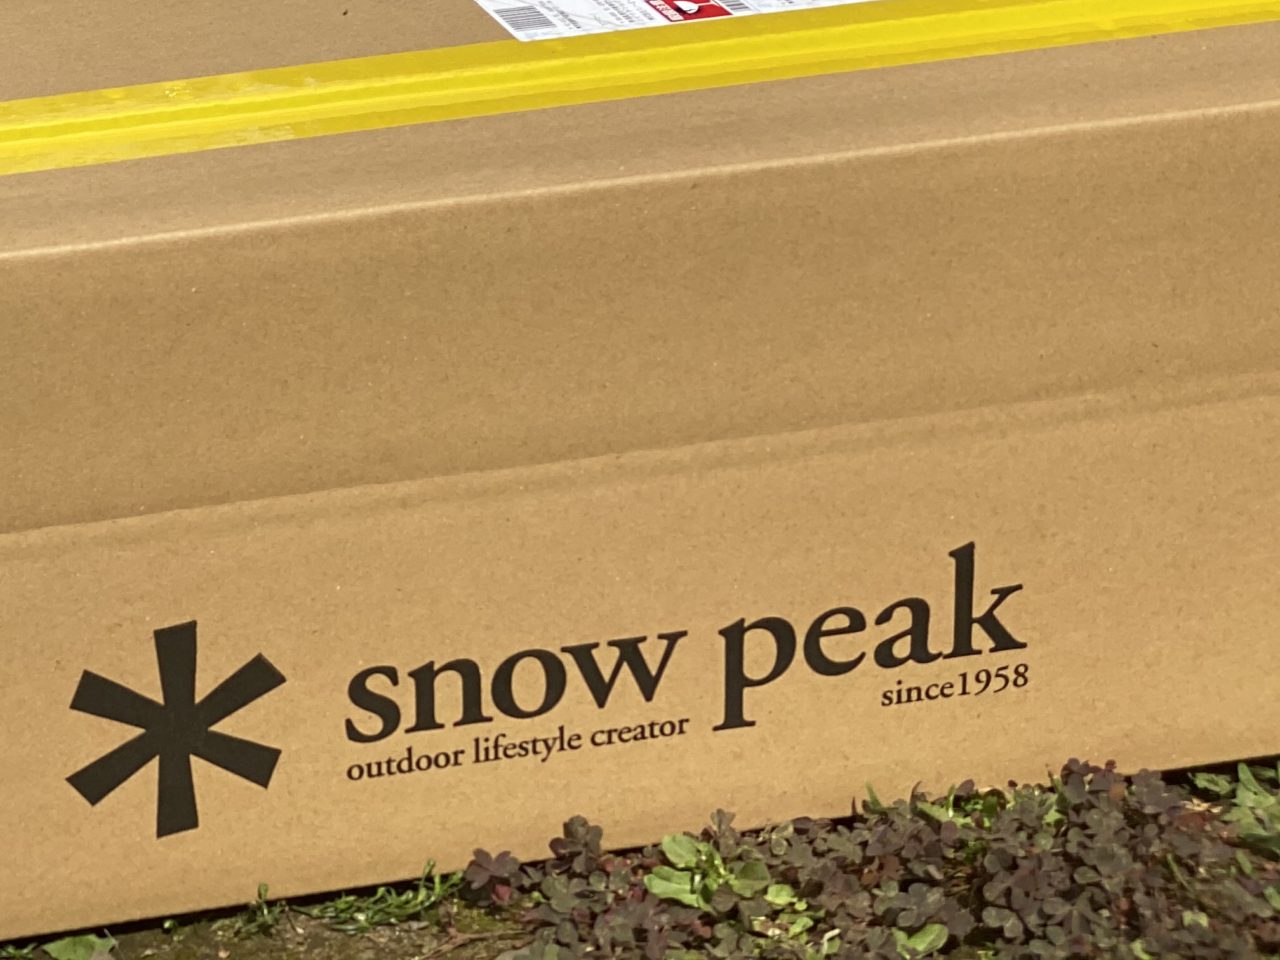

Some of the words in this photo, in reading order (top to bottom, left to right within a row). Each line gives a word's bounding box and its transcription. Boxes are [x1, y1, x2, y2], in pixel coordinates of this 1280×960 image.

[345, 630, 688, 744] snow
[712, 541, 1028, 732] peak
[881, 663, 1029, 707] since1958
[346, 746, 465, 781] outdoor
[473, 725, 582, 764] lifestyle
[590, 718, 690, 747] creator
